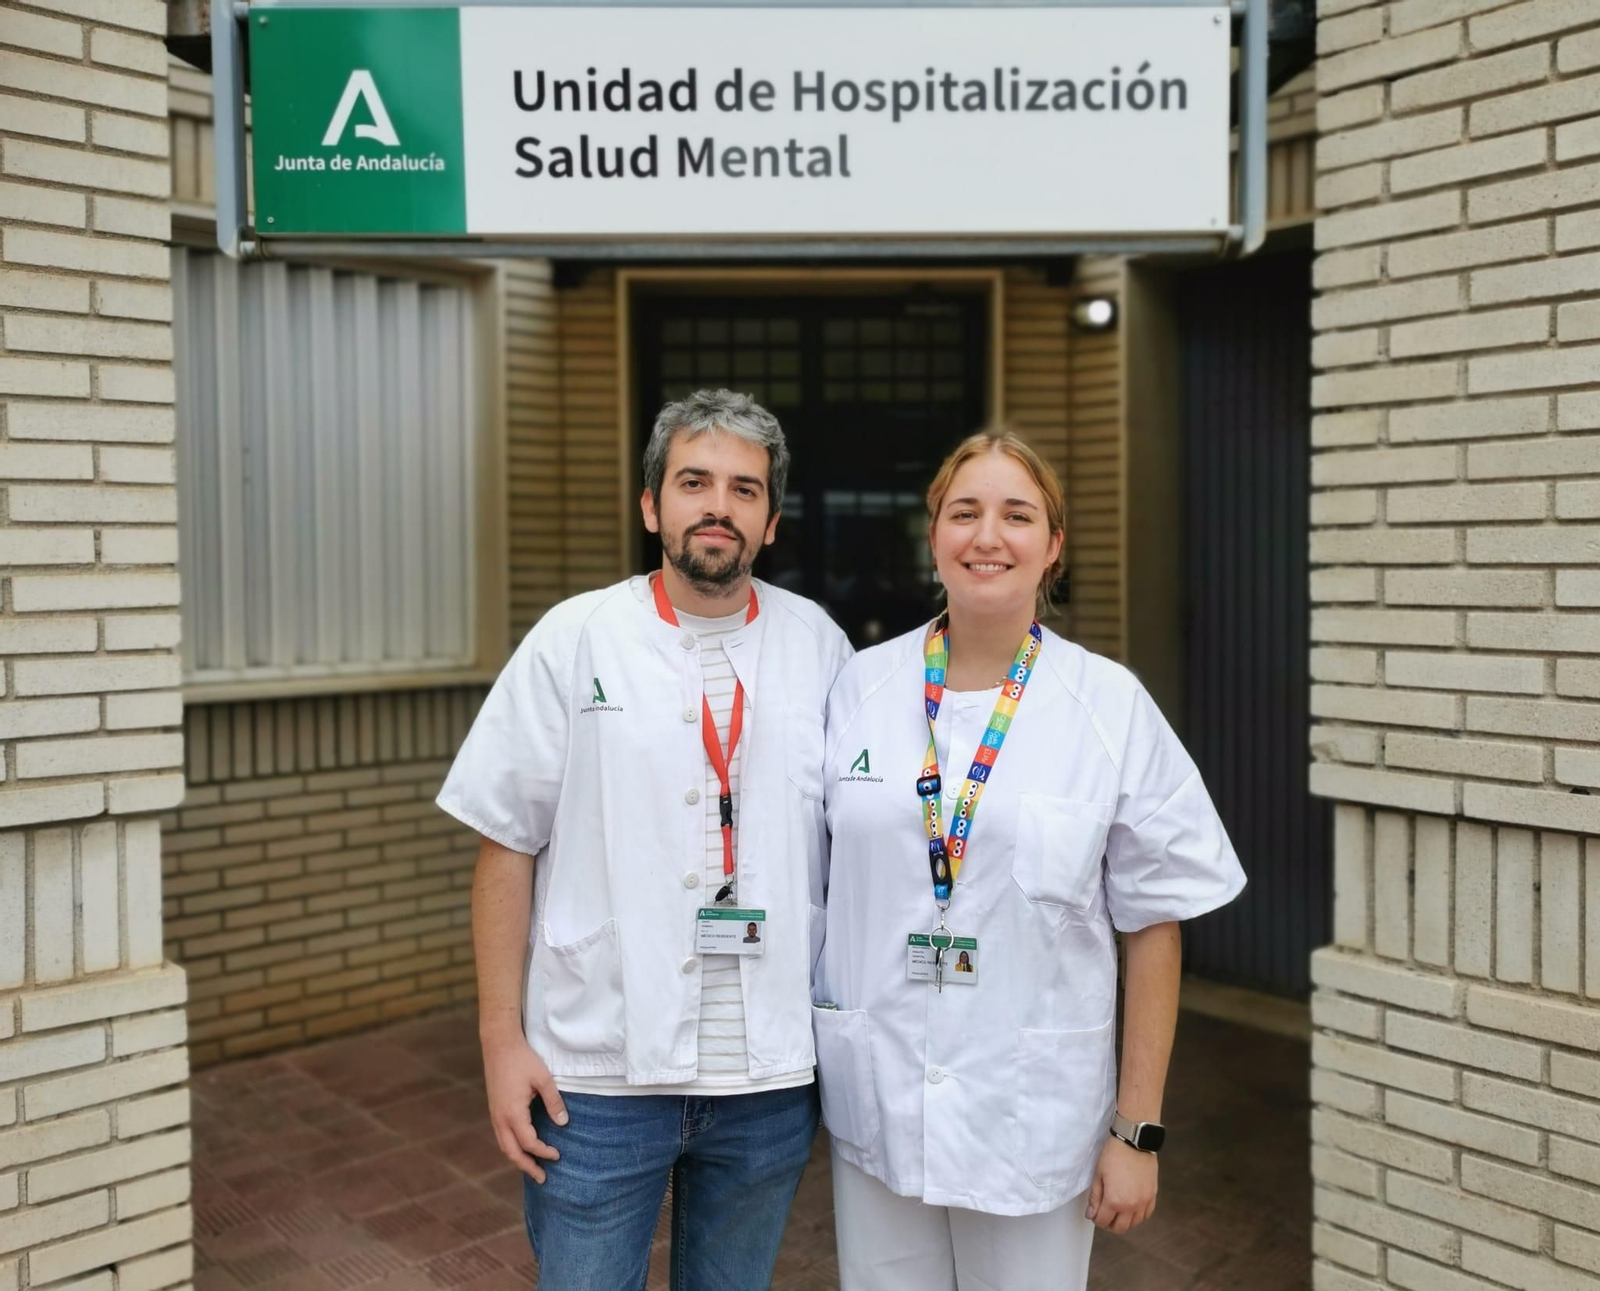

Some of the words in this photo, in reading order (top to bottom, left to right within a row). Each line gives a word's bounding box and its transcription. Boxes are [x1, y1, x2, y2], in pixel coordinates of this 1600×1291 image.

[514, 67, 697, 112] Unidad
[715, 68, 775, 112] de
[794, 61, 1188, 123] Hospitalización
[274, 155, 326, 172] Junta
[330, 154, 353, 171] de
[356, 152, 446, 172] Andalucía
[514, 134, 659, 179] Salud
[677, 134, 851, 179] Mental
[594, 704, 624, 712] ndalucía
